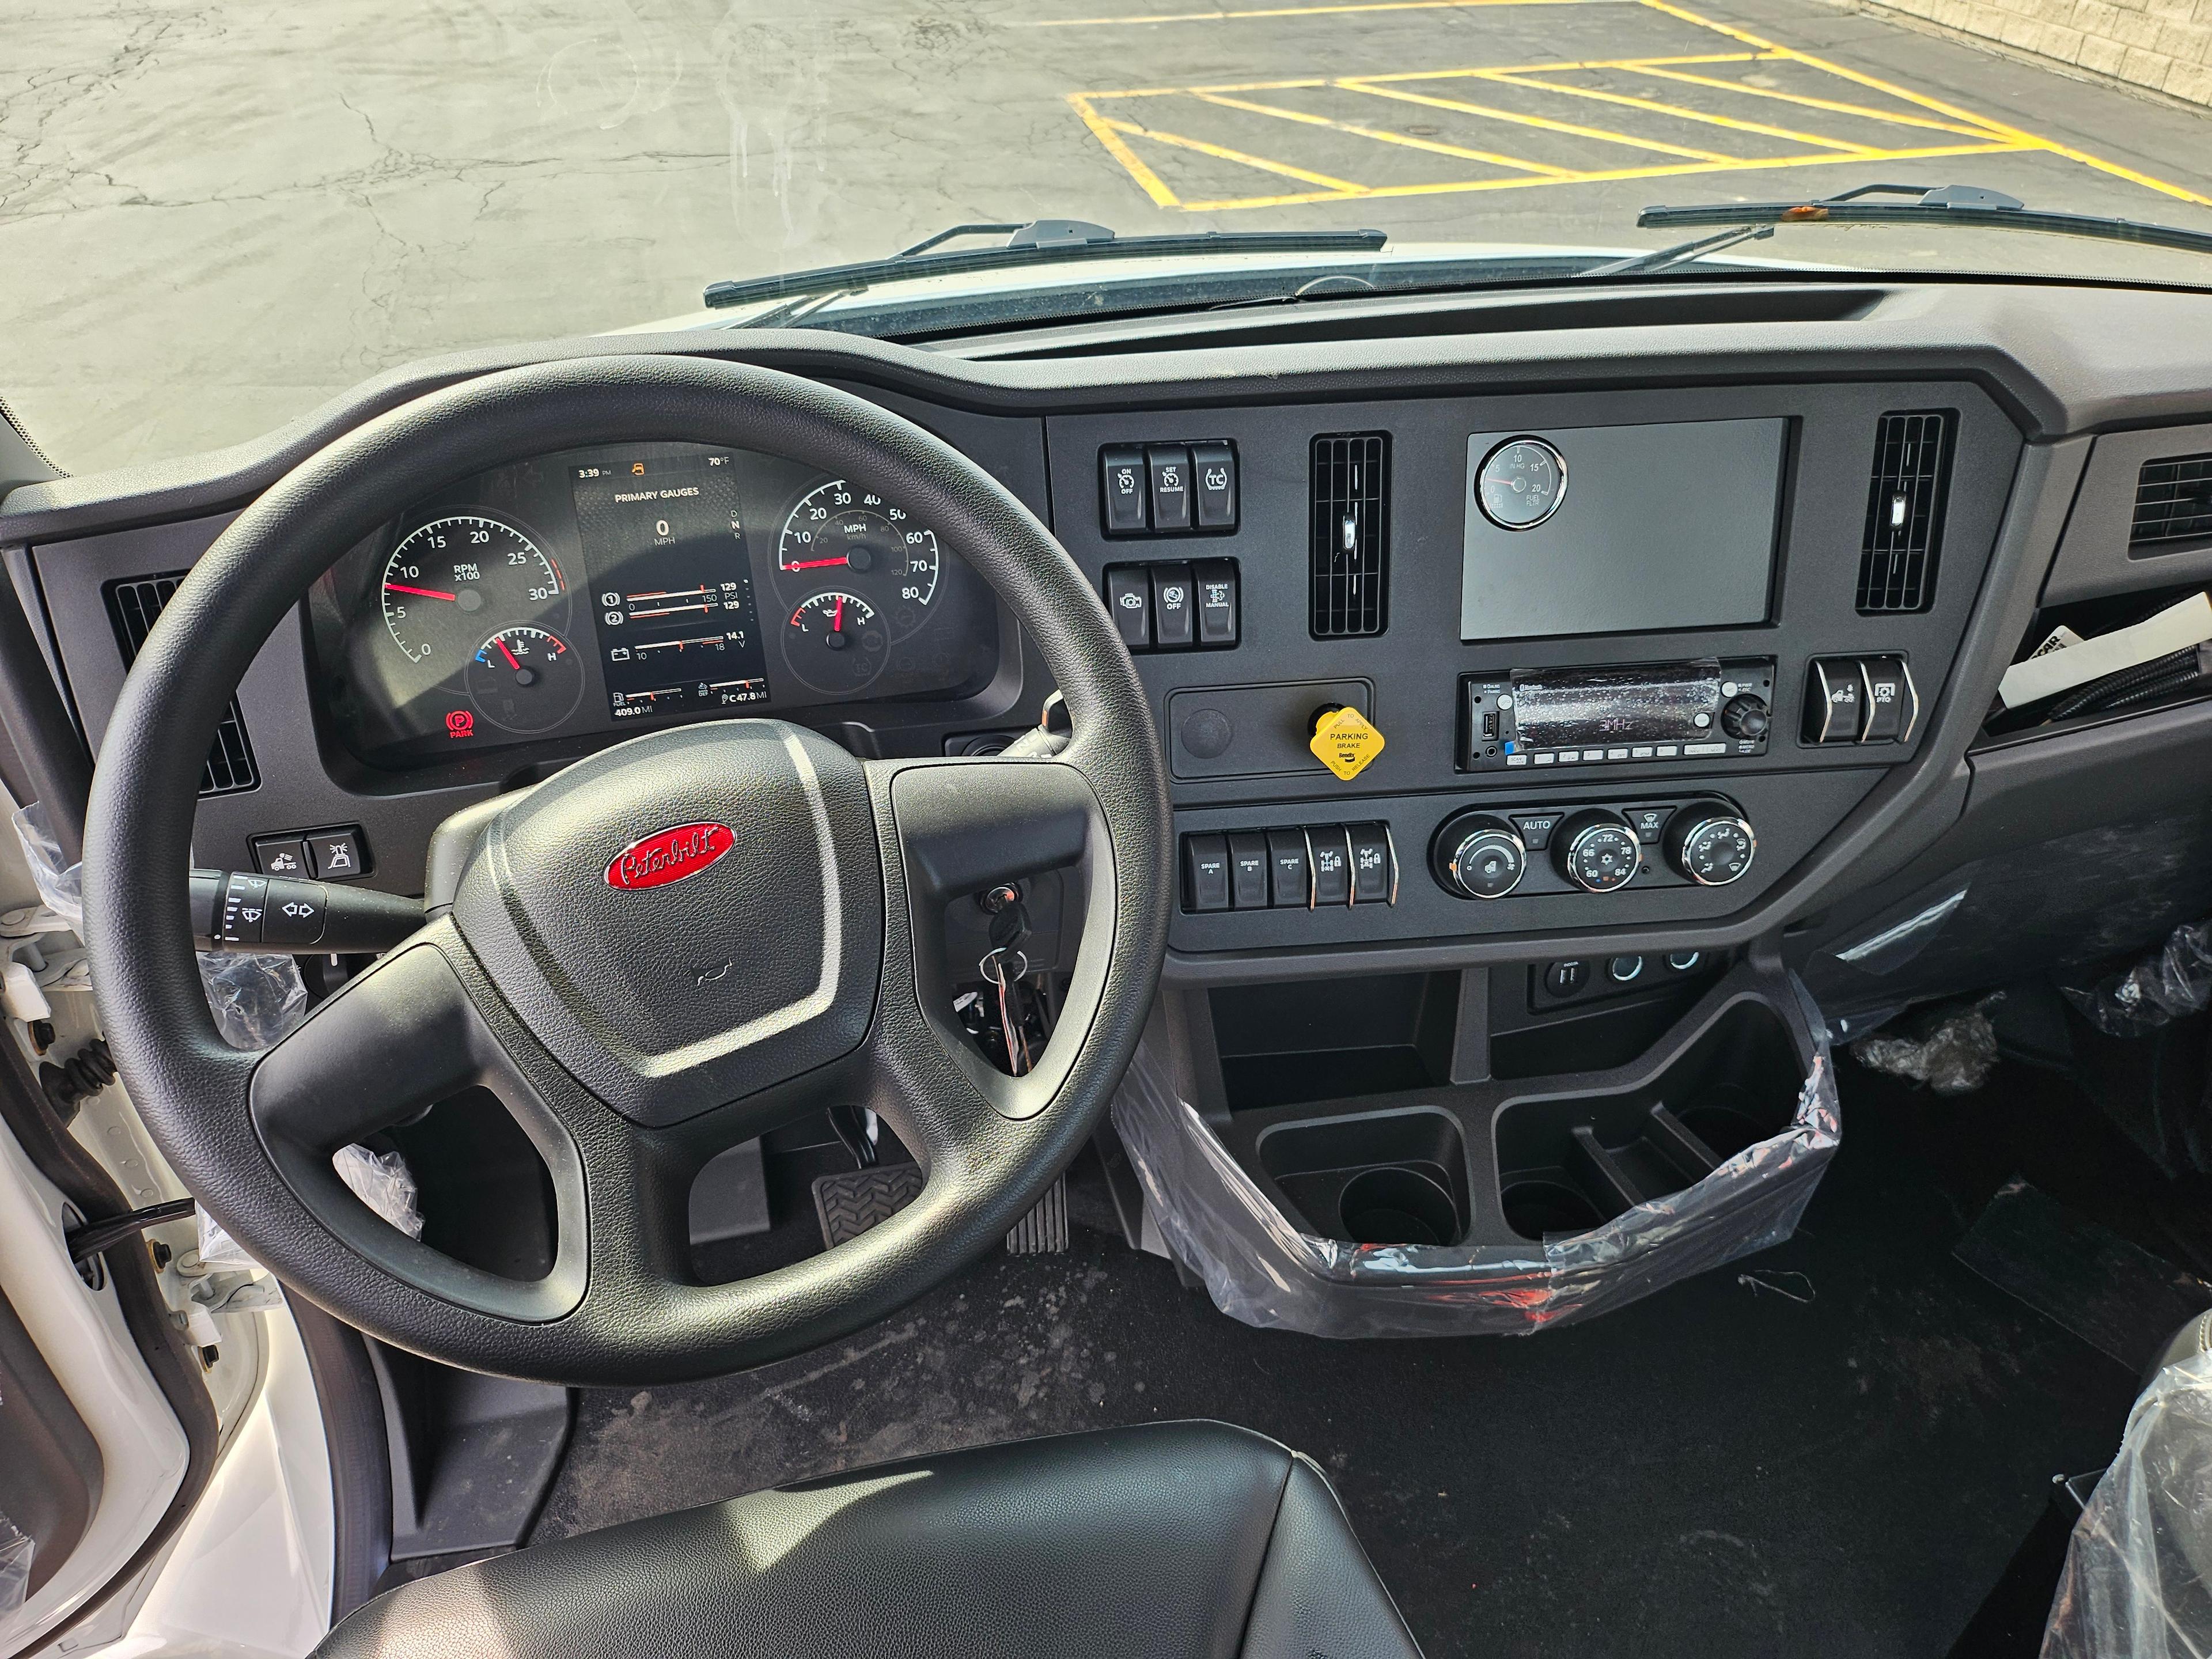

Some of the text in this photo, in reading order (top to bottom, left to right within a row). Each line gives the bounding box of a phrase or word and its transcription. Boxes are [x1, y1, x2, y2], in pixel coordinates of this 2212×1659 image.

[1513, 454, 1522, 463] 10
[1530, 463, 1539, 471] 15
[578, 468, 600, 478] 3:39
[1209, 475, 1224, 485] TC
[1490, 485, 1495, 493] 0
[1532, 484, 1541, 492] 20
[615, 487, 699, 503] PRIMARY GAUGES
[834, 493, 851, 505] 30
[863, 494, 881, 506] 40
[809, 507, 827, 520] 20
[889, 509, 907, 520] 50
[656, 519, 669, 536] 0
[730, 521, 741, 529] N
[844, 523, 866, 534] MPH
[469, 530, 490, 544] 20
[654, 537, 676, 546] MPH
[794, 531, 812, 544] 10
[847, 532, 866, 541] km/h
[906, 531, 923, 544] 60
[427, 536, 446, 549] 15
[507, 552, 527, 565] 25
[453, 563, 478, 574] RPM
[791, 560, 801, 572] 0
[910, 559, 927, 573] 70
[400, 566, 419, 579] 10
[720, 583, 737, 592] 129
[902, 586, 919, 600] 80
[528, 588, 548, 601] 30
[724, 592, 738, 601] PSI
[628, 594, 718, 611] 0 150
[724, 601, 740, 610] 129
[396, 606, 407, 619] 5
[857, 617, 865, 626] H
[801, 623, 809, 632] L
[726, 631, 744, 641] 14.1
[421, 643, 431, 656] 0
[636, 643, 725, 661] 10 18
[547, 652, 557, 662] H
[487, 660, 495, 668] L
[757, 691, 767, 699] MI
[642, 706, 653, 714] MI
[1334, 719, 1345, 729] PULL
[1355, 718, 1368, 730] APPLY
[449, 730, 474, 738] PARK
[1330, 760, 1342, 772] PUSH
[1351, 753, 1370, 772] RELEASE
[1523, 819, 1551, 831] AUTO
[1602, 834, 1614, 843] 72
[620, 826, 719, 885] Peterbilt
[1583, 849, 1595, 857] 66
[1620, 846, 1631, 855] 78
[1586, 869, 1599, 878] 60
[1615, 867, 1626, 876] 84
